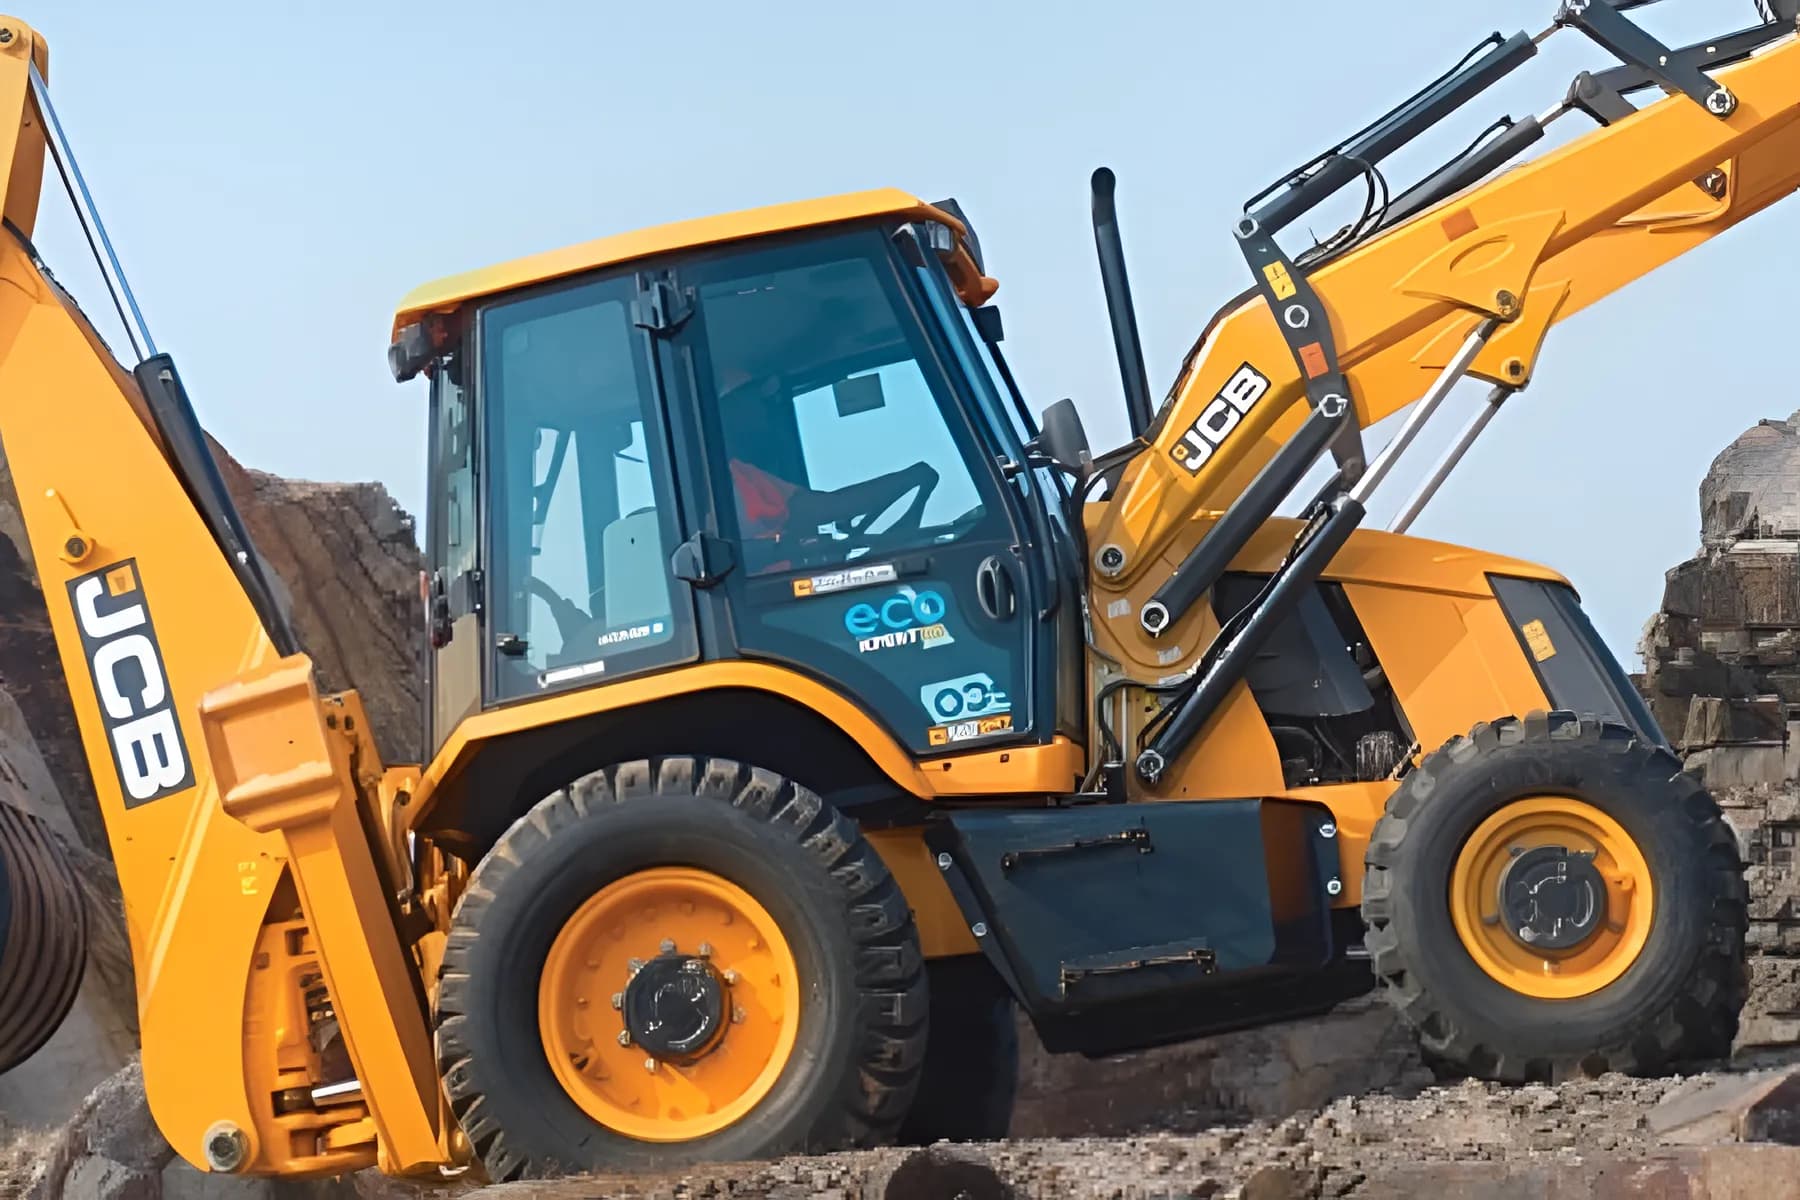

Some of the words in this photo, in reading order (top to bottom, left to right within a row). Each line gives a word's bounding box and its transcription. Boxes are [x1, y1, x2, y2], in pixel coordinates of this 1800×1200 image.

[1184, 366, 1270, 471] JCB
[844, 590, 946, 636] eco
[75, 575, 187, 800] JCB
